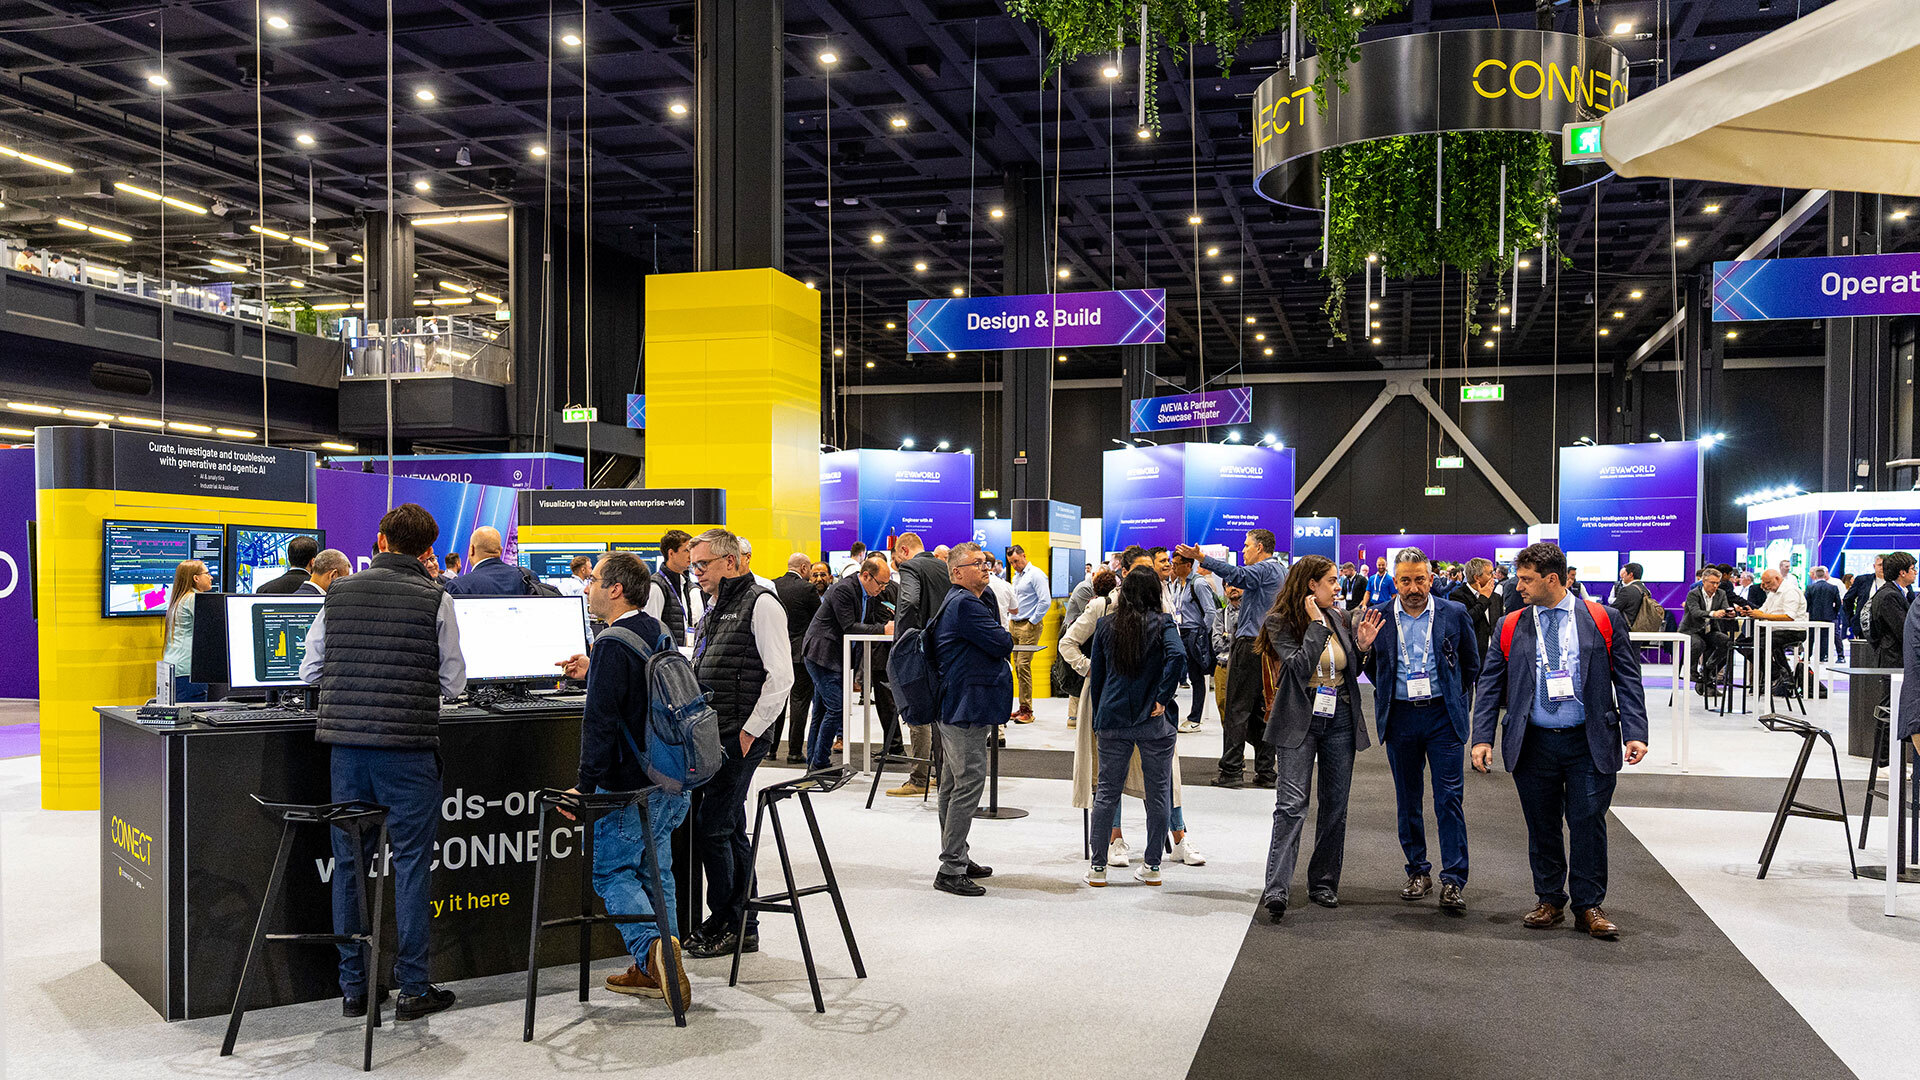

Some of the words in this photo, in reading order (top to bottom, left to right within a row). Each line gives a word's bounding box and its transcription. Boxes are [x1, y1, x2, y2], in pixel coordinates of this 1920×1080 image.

[1473, 59, 1629, 112] CONNEC
[1821, 270, 1920, 301] Operat
[967, 311, 1030, 333] Design
[1034, 310, 1049, 328] &
[1054, 307, 1101, 327] Build
[1157, 413, 1192, 424] Showcase
[1192, 410, 1220, 420] Theater
[1160, 402, 1183, 413] AVEVA
[1183, 401, 1189, 411] &
[1190, 400, 1217, 410] Partner
[148, 441, 176, 455] Curate,
[177, 444, 218, 459] investigate
[219, 450, 233, 460] and
[234, 451, 276, 464] troubleshoot
[159, 456, 176, 467] with
[178, 459, 217, 470] generative
[218, 462, 231, 472] and
[233, 464, 258, 475] agentic
[259, 465, 266, 475] AI
[1600, 464, 1656, 474] AVEVAWORLD
[539, 499, 575, 509] Visualizing
[576, 499, 588, 508] the
[589, 499, 610, 509] digital
[611, 499, 628, 508] twin,
[629, 498, 685, 508] enterprise-wide
[441, 788, 541, 821] ds-o
[111, 815, 153, 866] CONNECT
[450, 894, 462, 912] it
[468, 892, 510, 910] here
